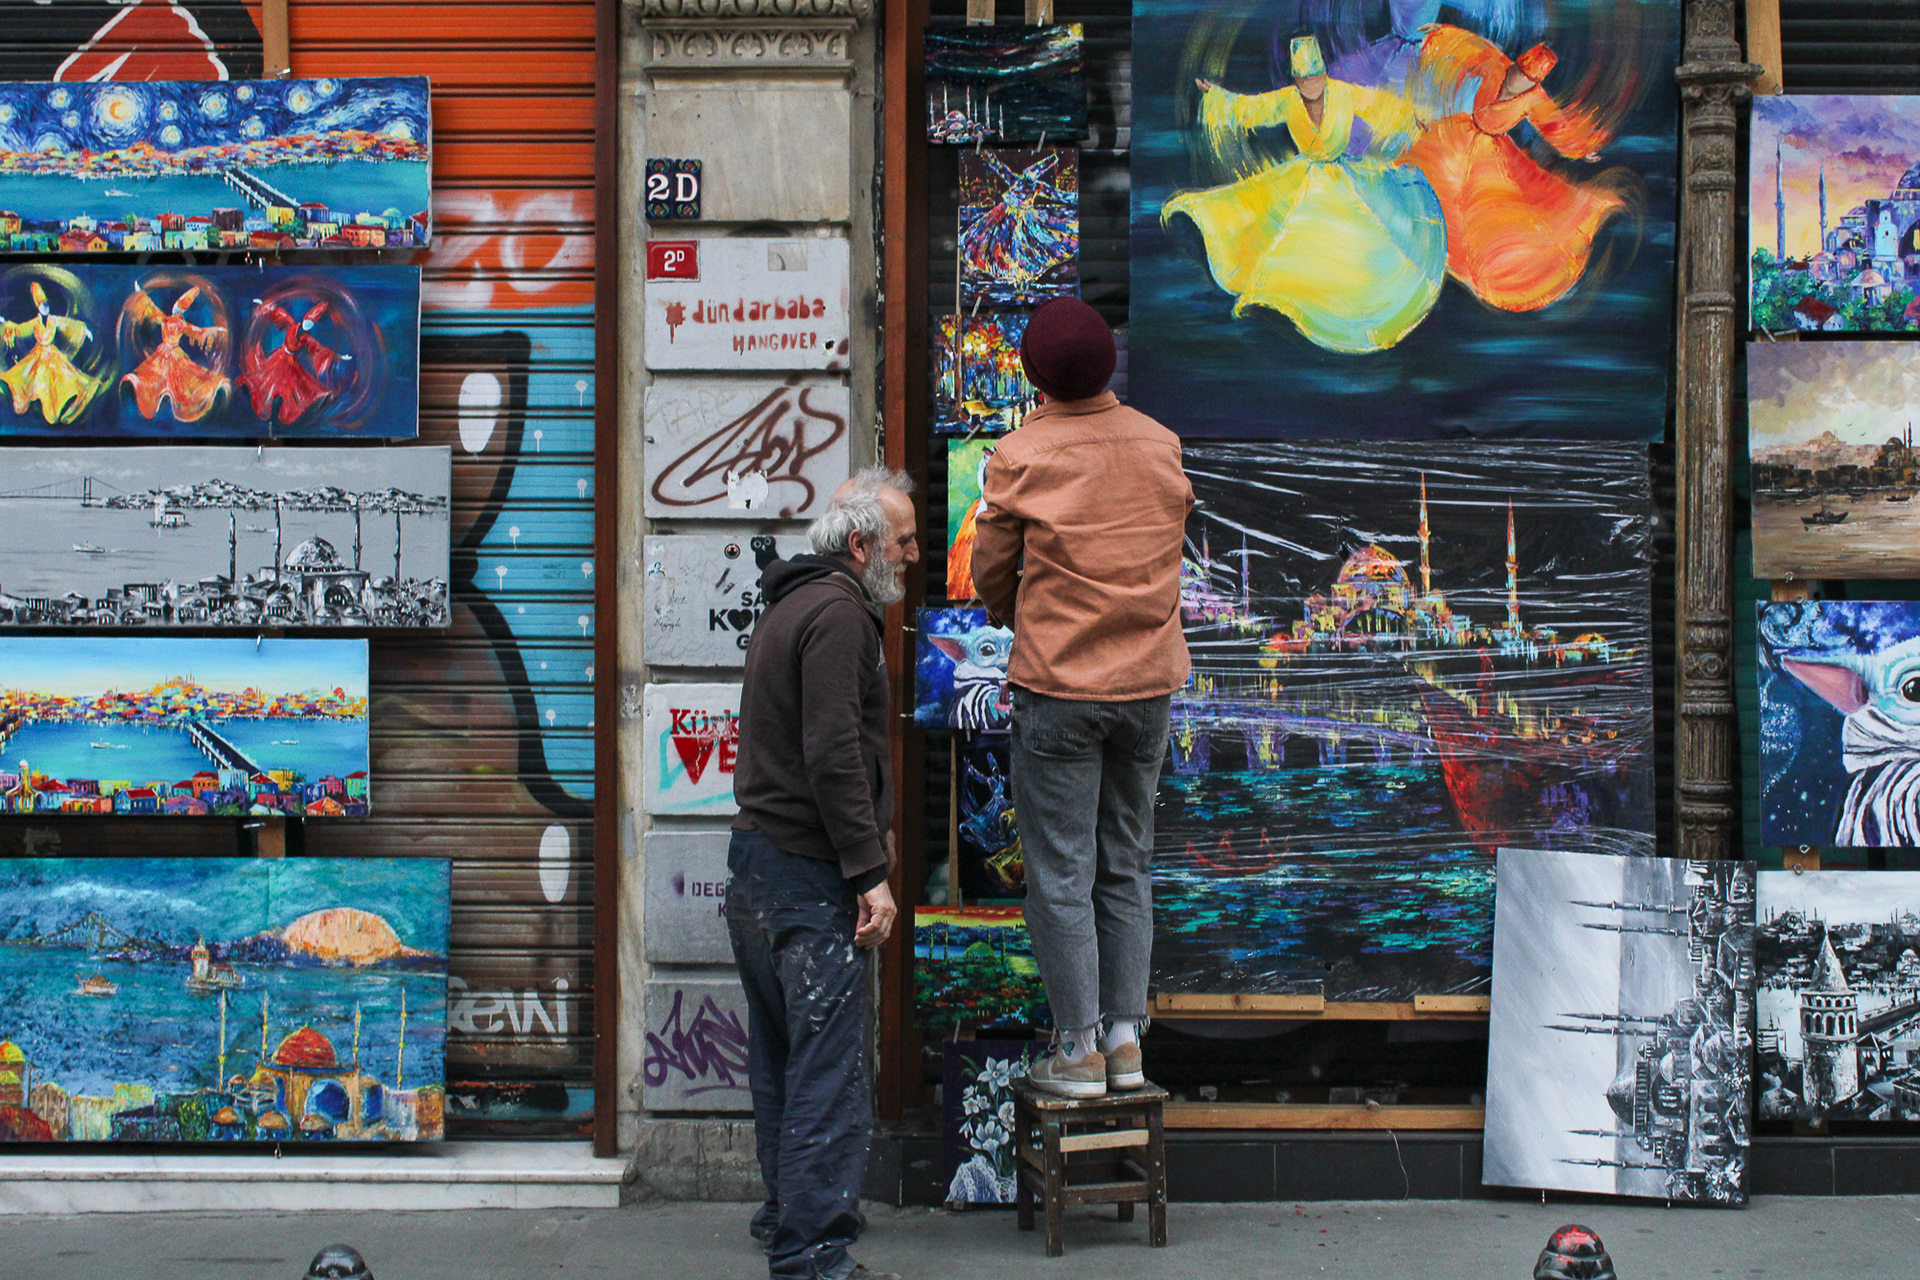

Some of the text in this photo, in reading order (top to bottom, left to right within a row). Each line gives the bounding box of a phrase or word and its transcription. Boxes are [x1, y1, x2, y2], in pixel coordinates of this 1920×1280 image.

[647, 173, 698, 202] 2D
[663, 250, 685, 271] 2D
[733, 332, 817, 353] HANGOVER
